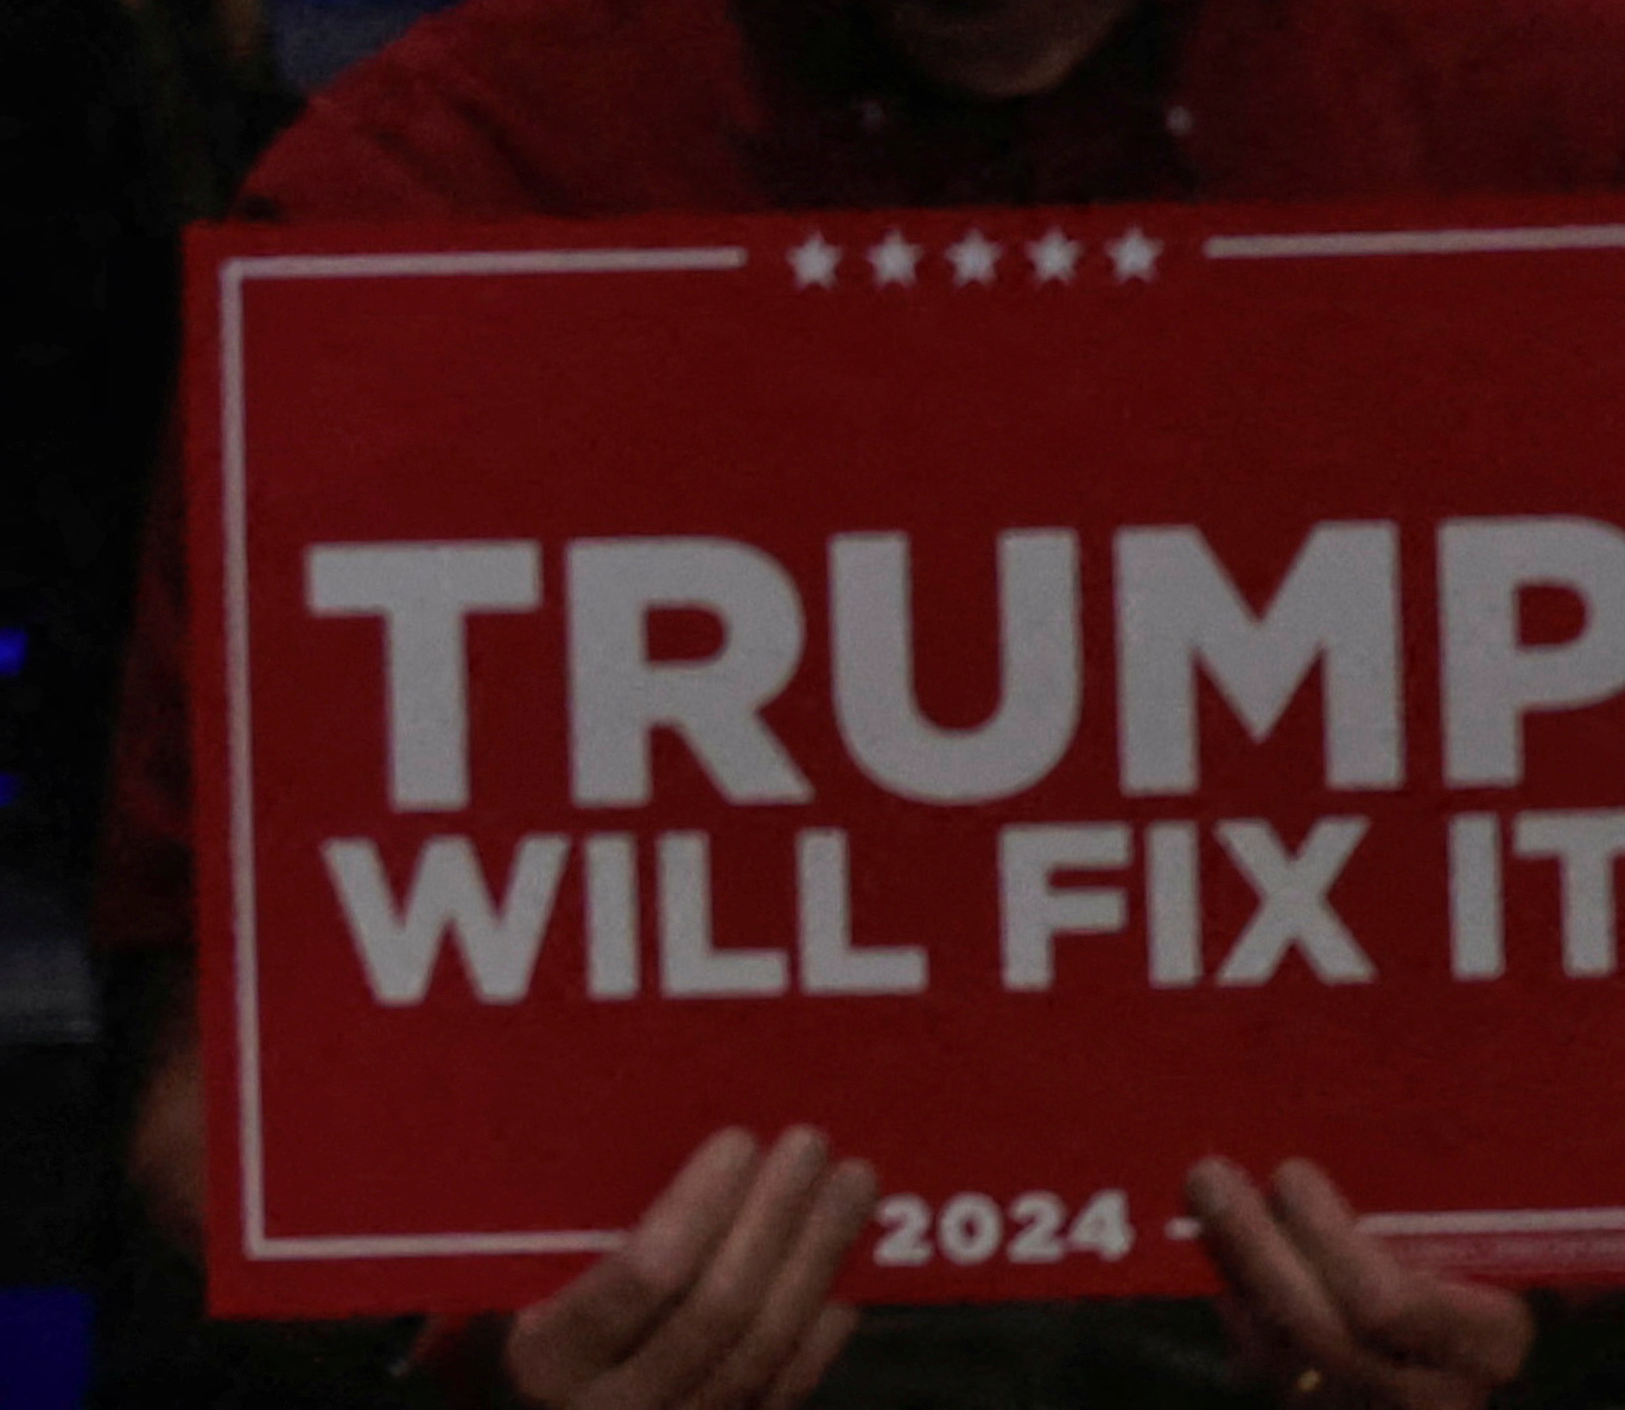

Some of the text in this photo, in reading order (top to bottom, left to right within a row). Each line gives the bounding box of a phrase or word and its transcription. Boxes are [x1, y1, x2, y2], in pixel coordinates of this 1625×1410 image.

[305, 513, 1625, 813] TRUMP
[321, 829, 929, 1007] WILL
[997, 815, 1377, 991] FIX
[871, 1187, 1135, 1267] 2024
